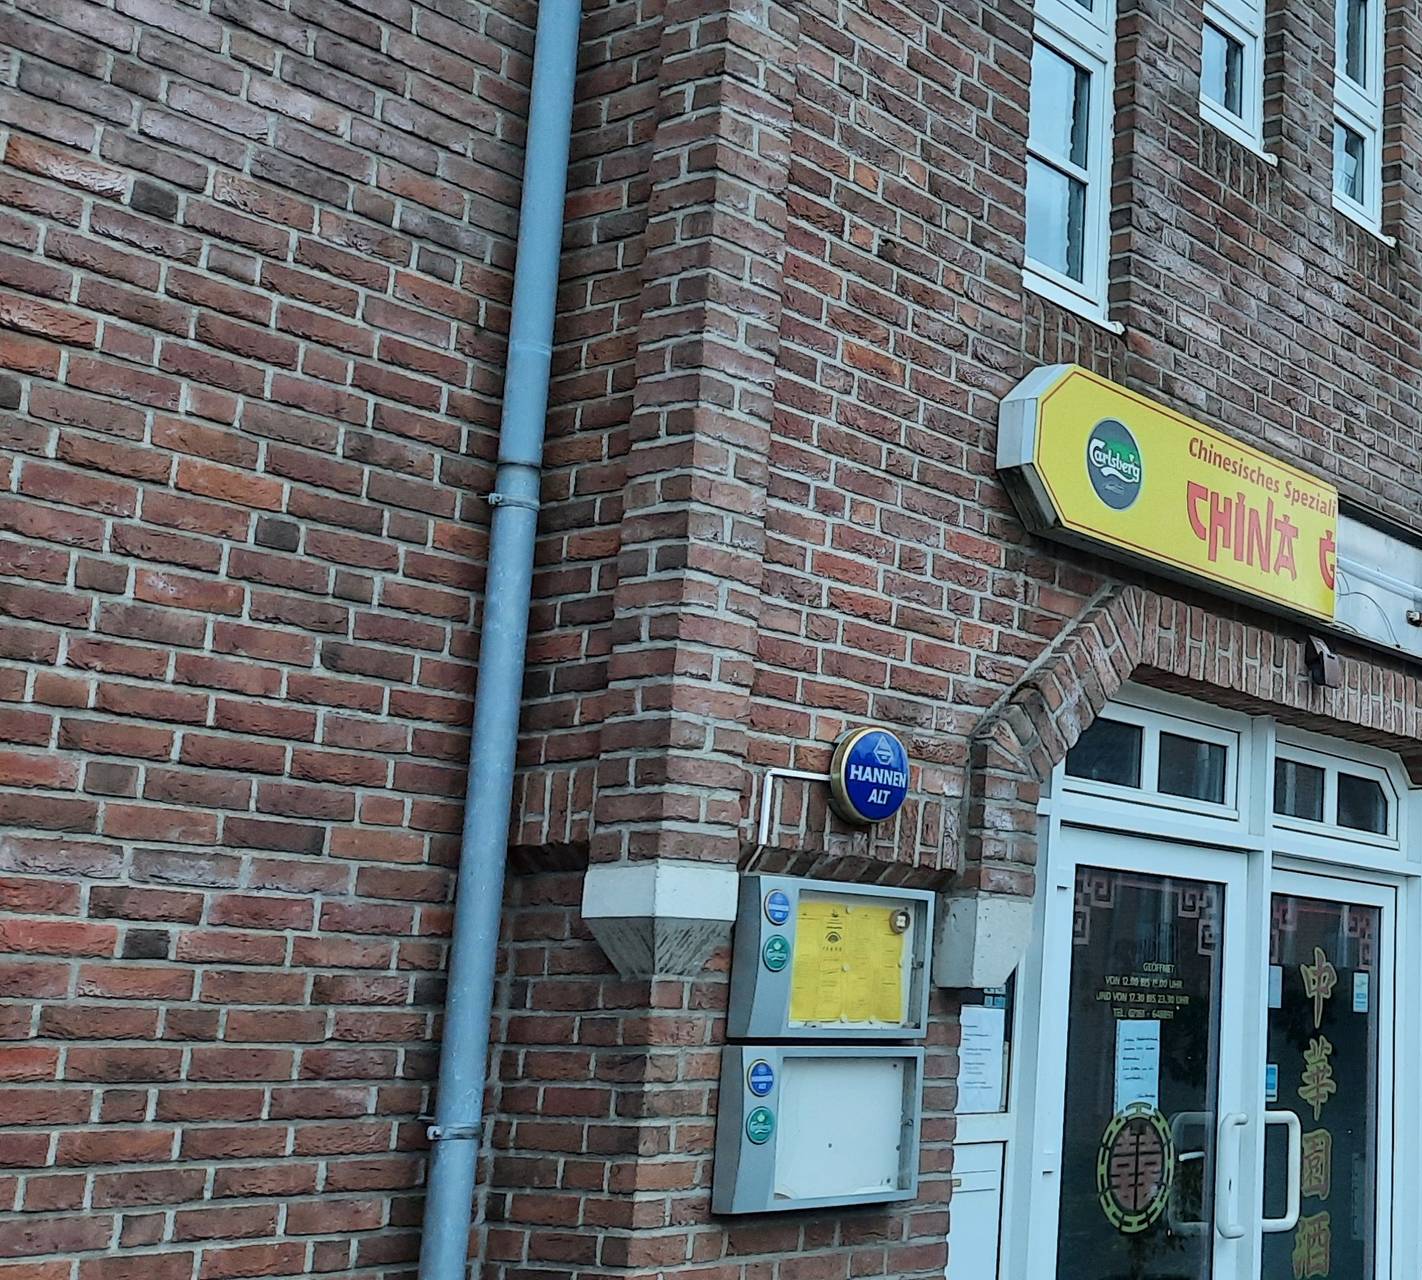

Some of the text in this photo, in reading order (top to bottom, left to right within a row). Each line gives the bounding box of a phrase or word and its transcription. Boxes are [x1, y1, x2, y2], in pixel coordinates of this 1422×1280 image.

[1089, 438, 1141, 483] Carlsberg
[1189, 436, 1336, 519] Chinesisches Speziali
[1186, 479, 1299, 582] CHINA
[849, 764, 907, 788] HANNEN
[867, 788, 891, 805] ALT
[1112, 992, 1127, 1002] VON
